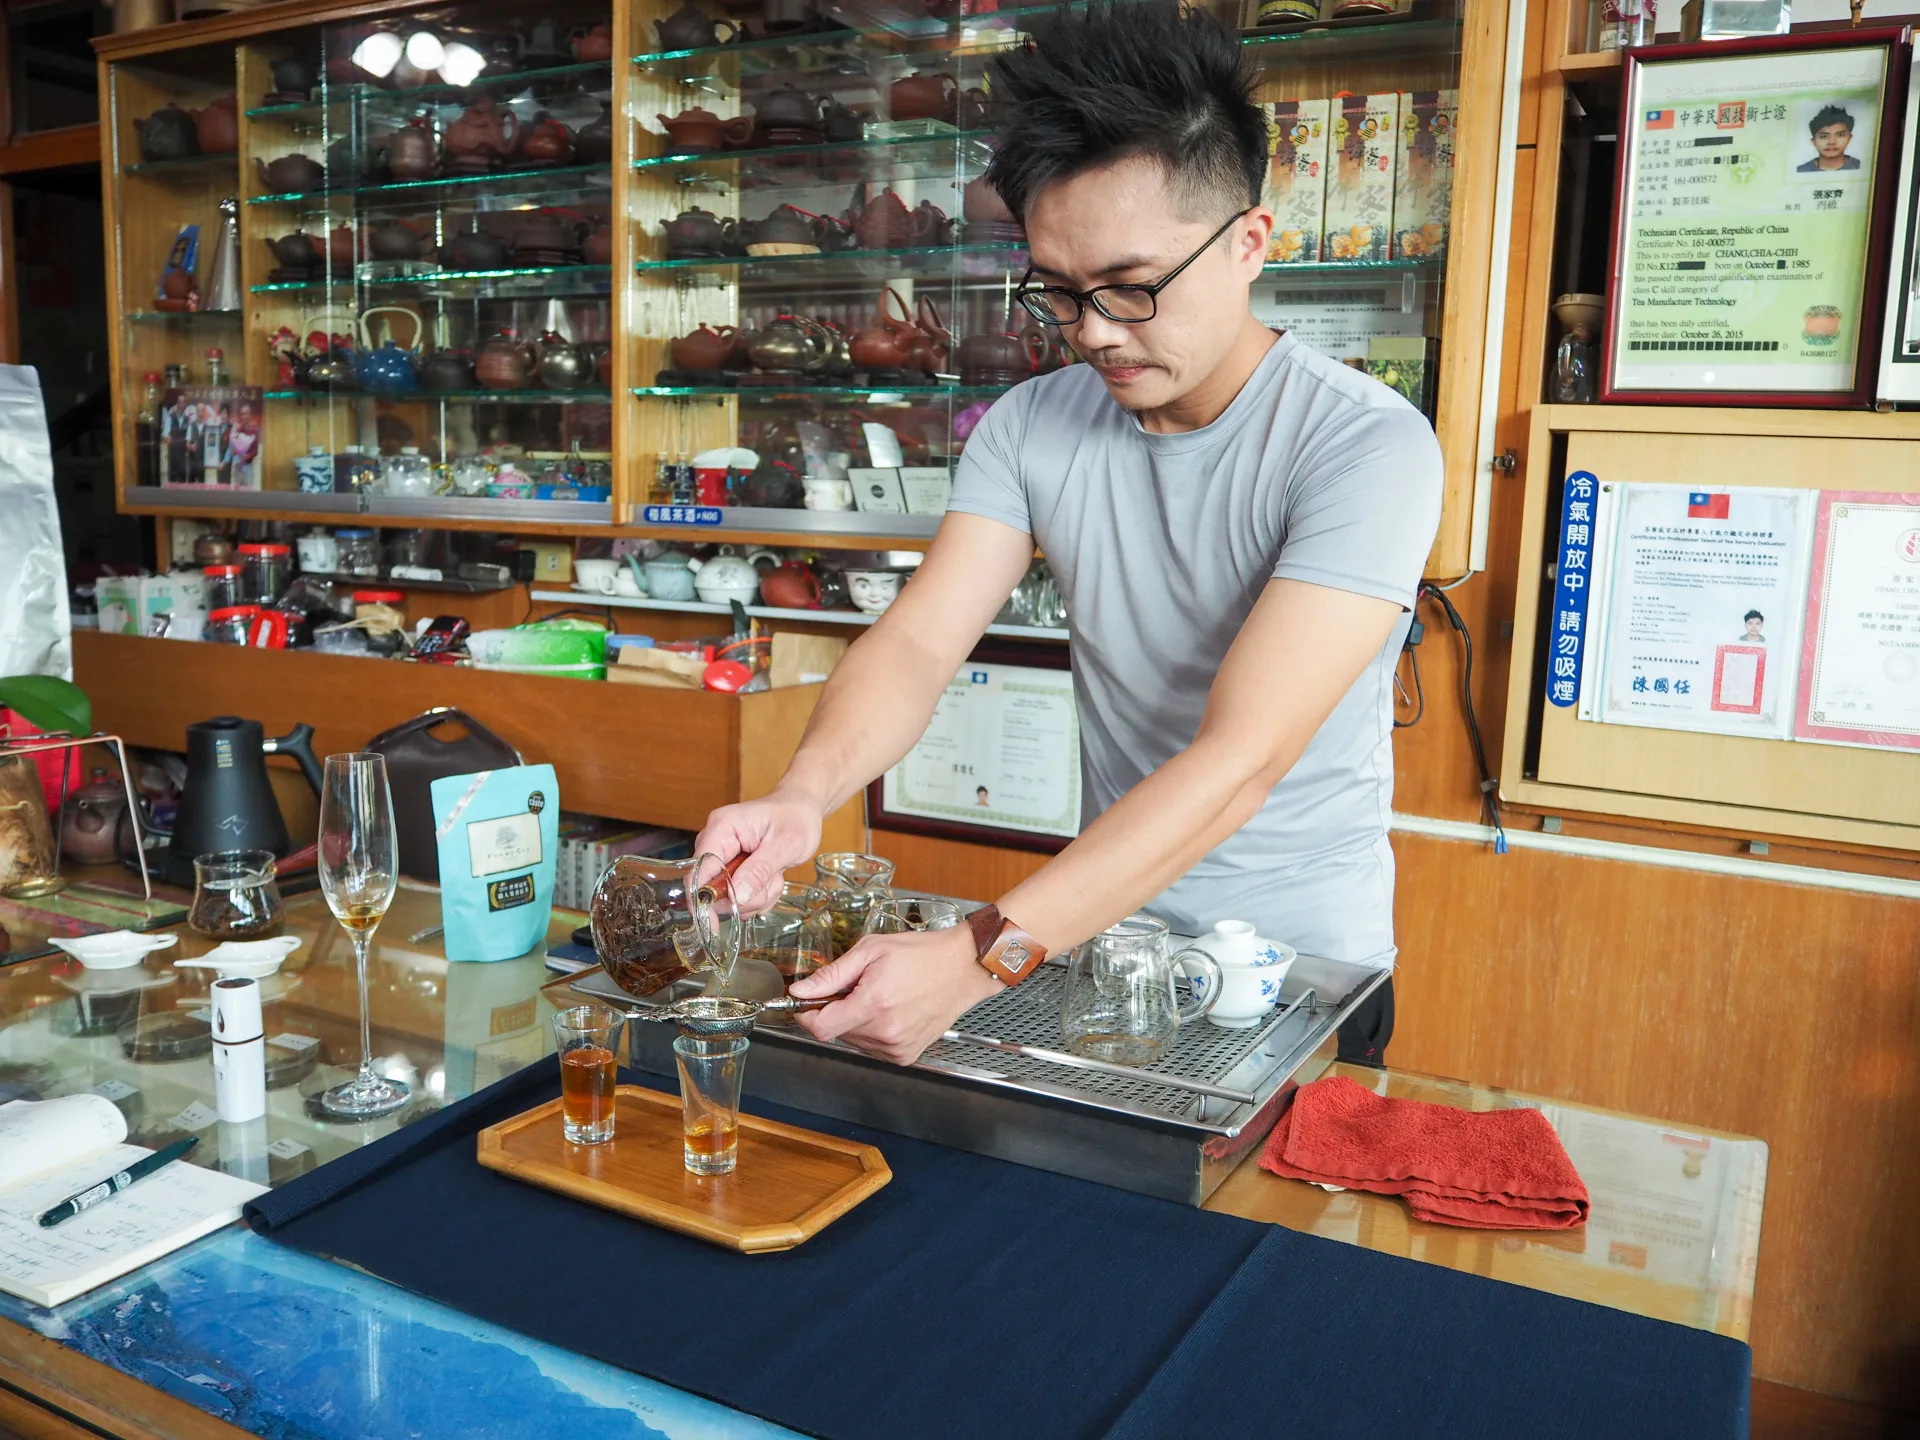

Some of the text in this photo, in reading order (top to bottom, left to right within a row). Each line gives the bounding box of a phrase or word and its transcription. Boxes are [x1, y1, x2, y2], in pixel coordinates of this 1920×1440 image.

[1679, 103, 1787, 128] 中華民國技術士證
[1674, 175, 1717, 185] 161-000572
[1638, 225, 1789, 237] Technician Certificate, Republic of China
[1636, 238, 1735, 248] Certificate No. 161-000572
[1637, 251, 1651, 259] This
[1671, 249, 1694, 259] certify
[1696, 250, 1710, 258] that
[1635, 262, 1645, 270] ID
[1714, 260, 1732, 270] born
[1744, 260, 1775, 270] October
[1791, 259, 1811, 269] 1985
[1634, 271, 1824, 283] has passed the required qualification examination of
[1632, 284, 1719, 295] class C skill category of
[1632, 296, 1738, 307] Tea Manufacture Technology
[1630, 320, 1645, 328] thus
[1646, 319, 1658, 327] has
[1660, 319, 1678, 328] been
[1679, 318, 1696, 328] duly
[1629, 330, 1660, 339] effective
[1680, 330, 1710, 339] October
[1711, 330, 1722, 339] 26,
[1725, 330, 1744, 339] 2015
